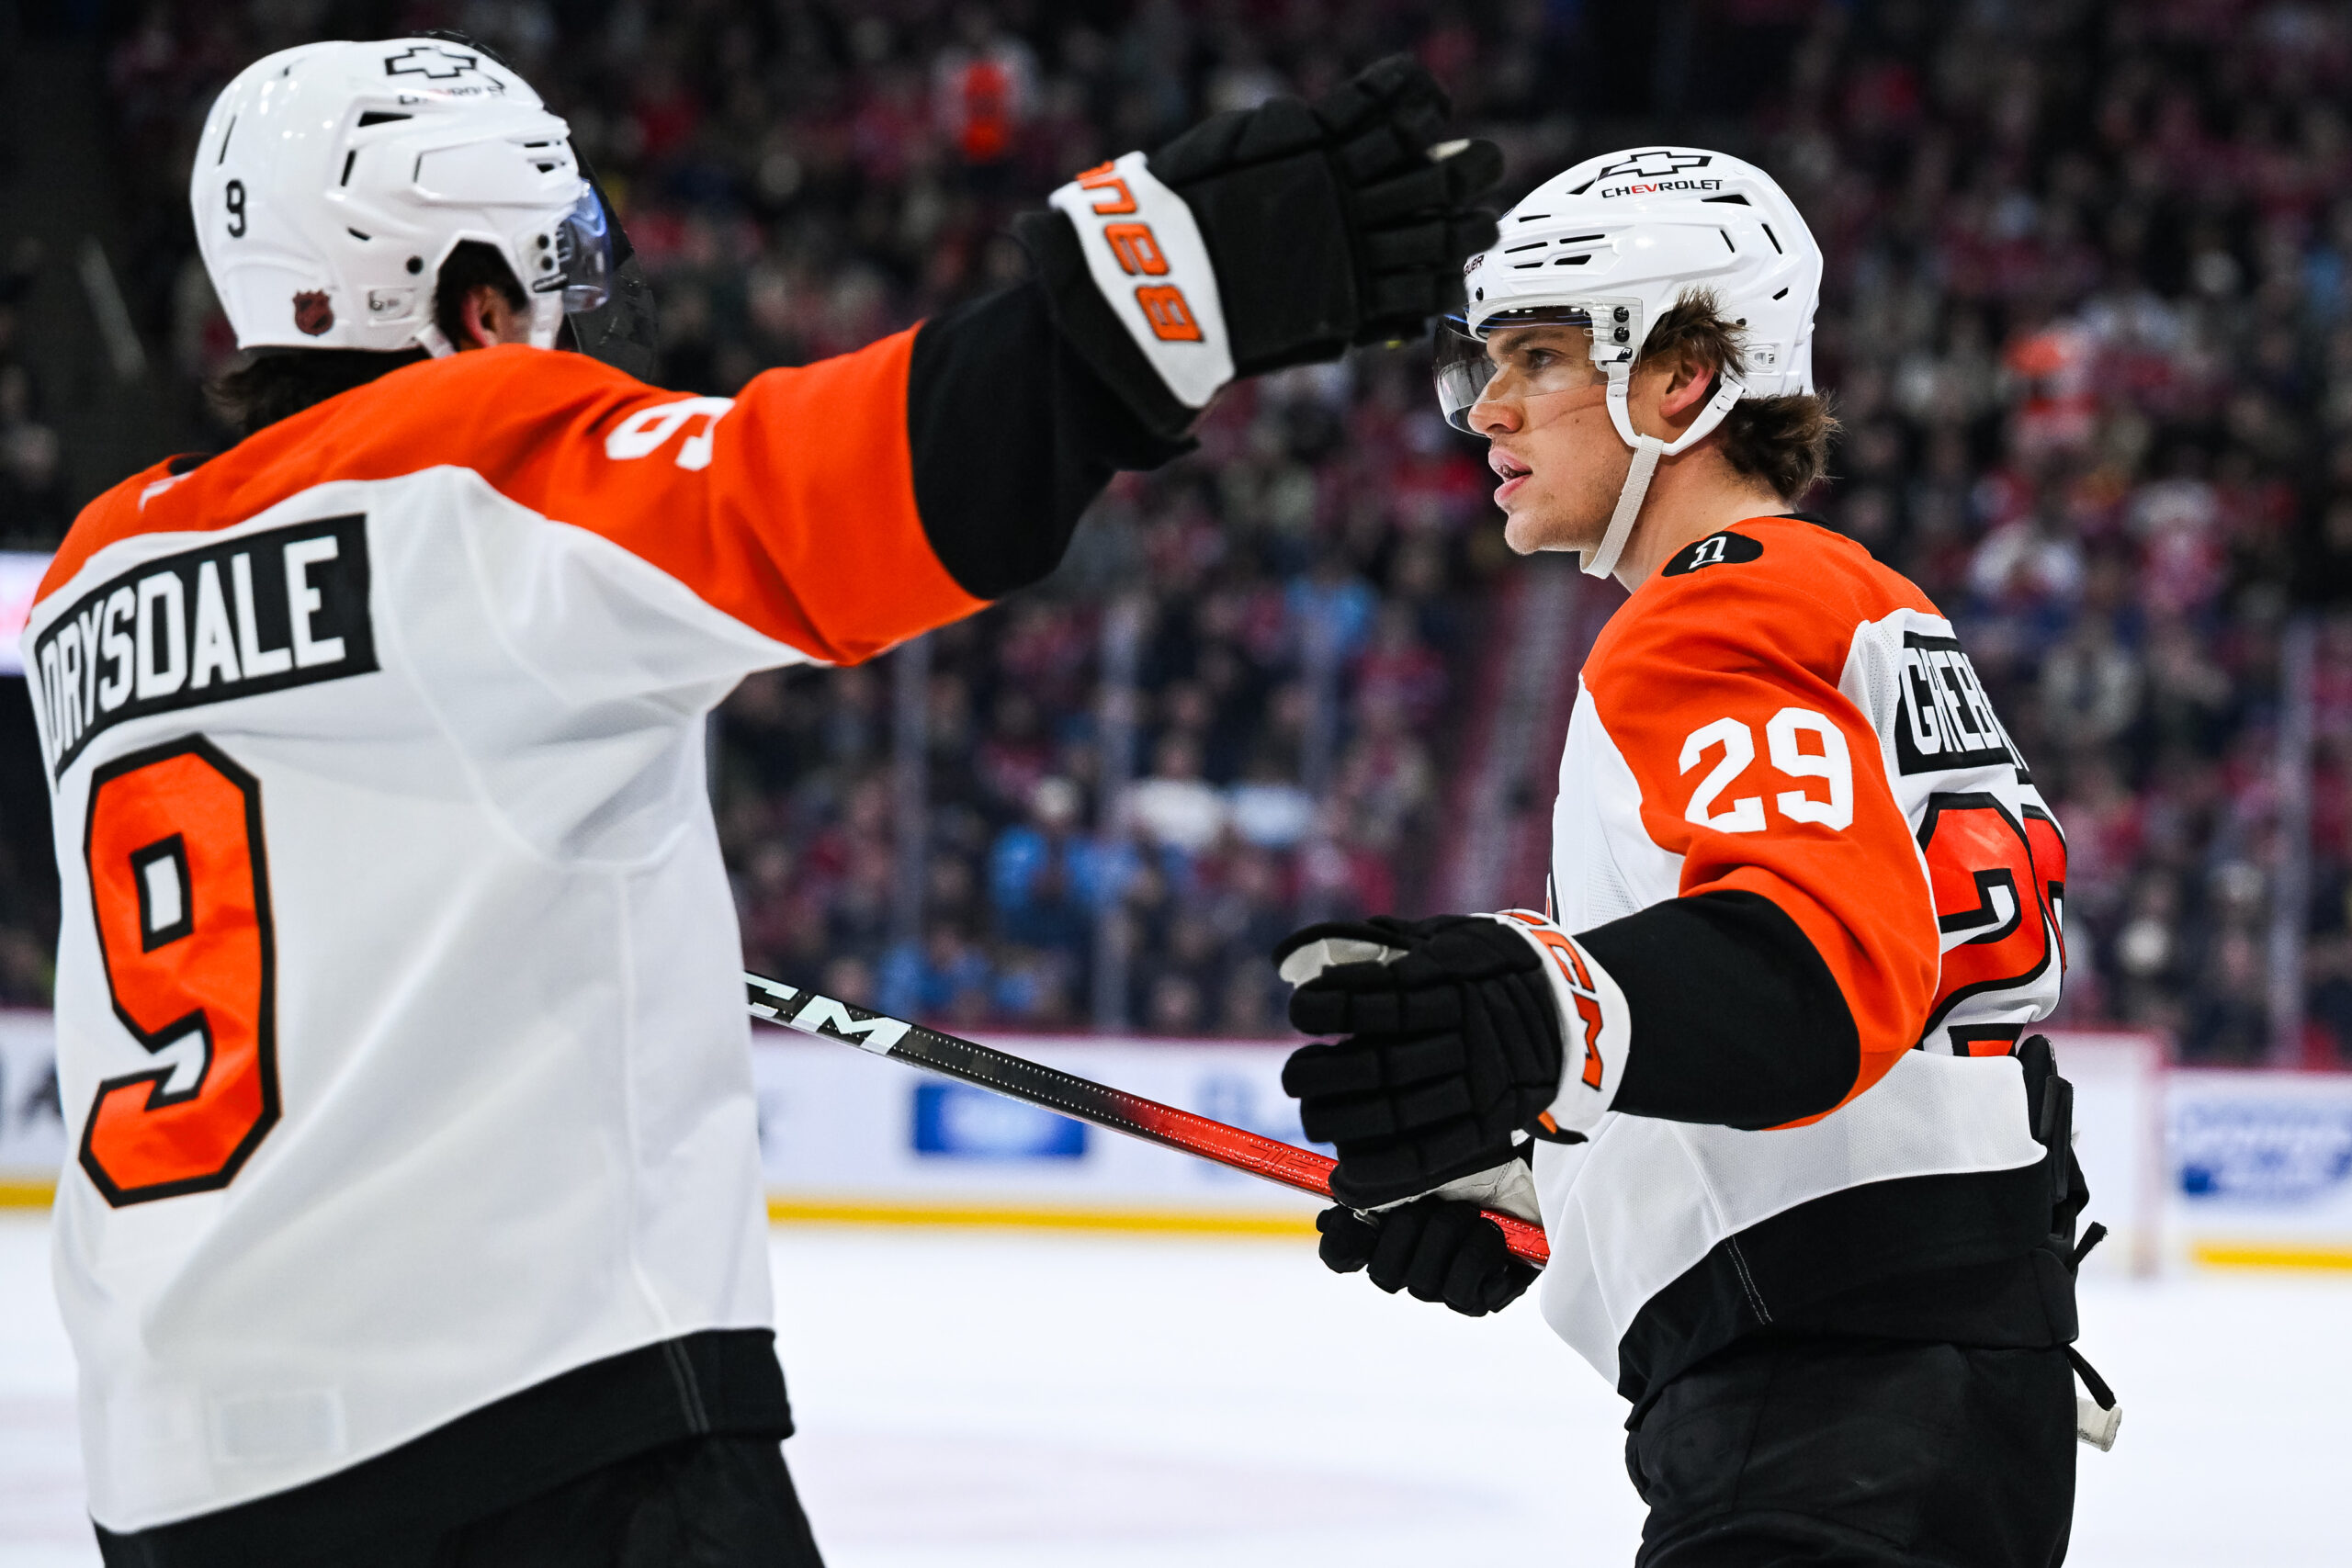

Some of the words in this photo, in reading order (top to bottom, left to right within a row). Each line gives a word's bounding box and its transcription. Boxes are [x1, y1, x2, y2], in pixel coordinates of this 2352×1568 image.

[226, 179, 246, 238] 9
[1601, 179, 1724, 198] CHEVROLET
[605, 396, 736, 471] 9
[40, 535, 346, 766] DRYSDALE
[1679, 707, 1854, 833] 29
[77, 731, 282, 1209] 9
